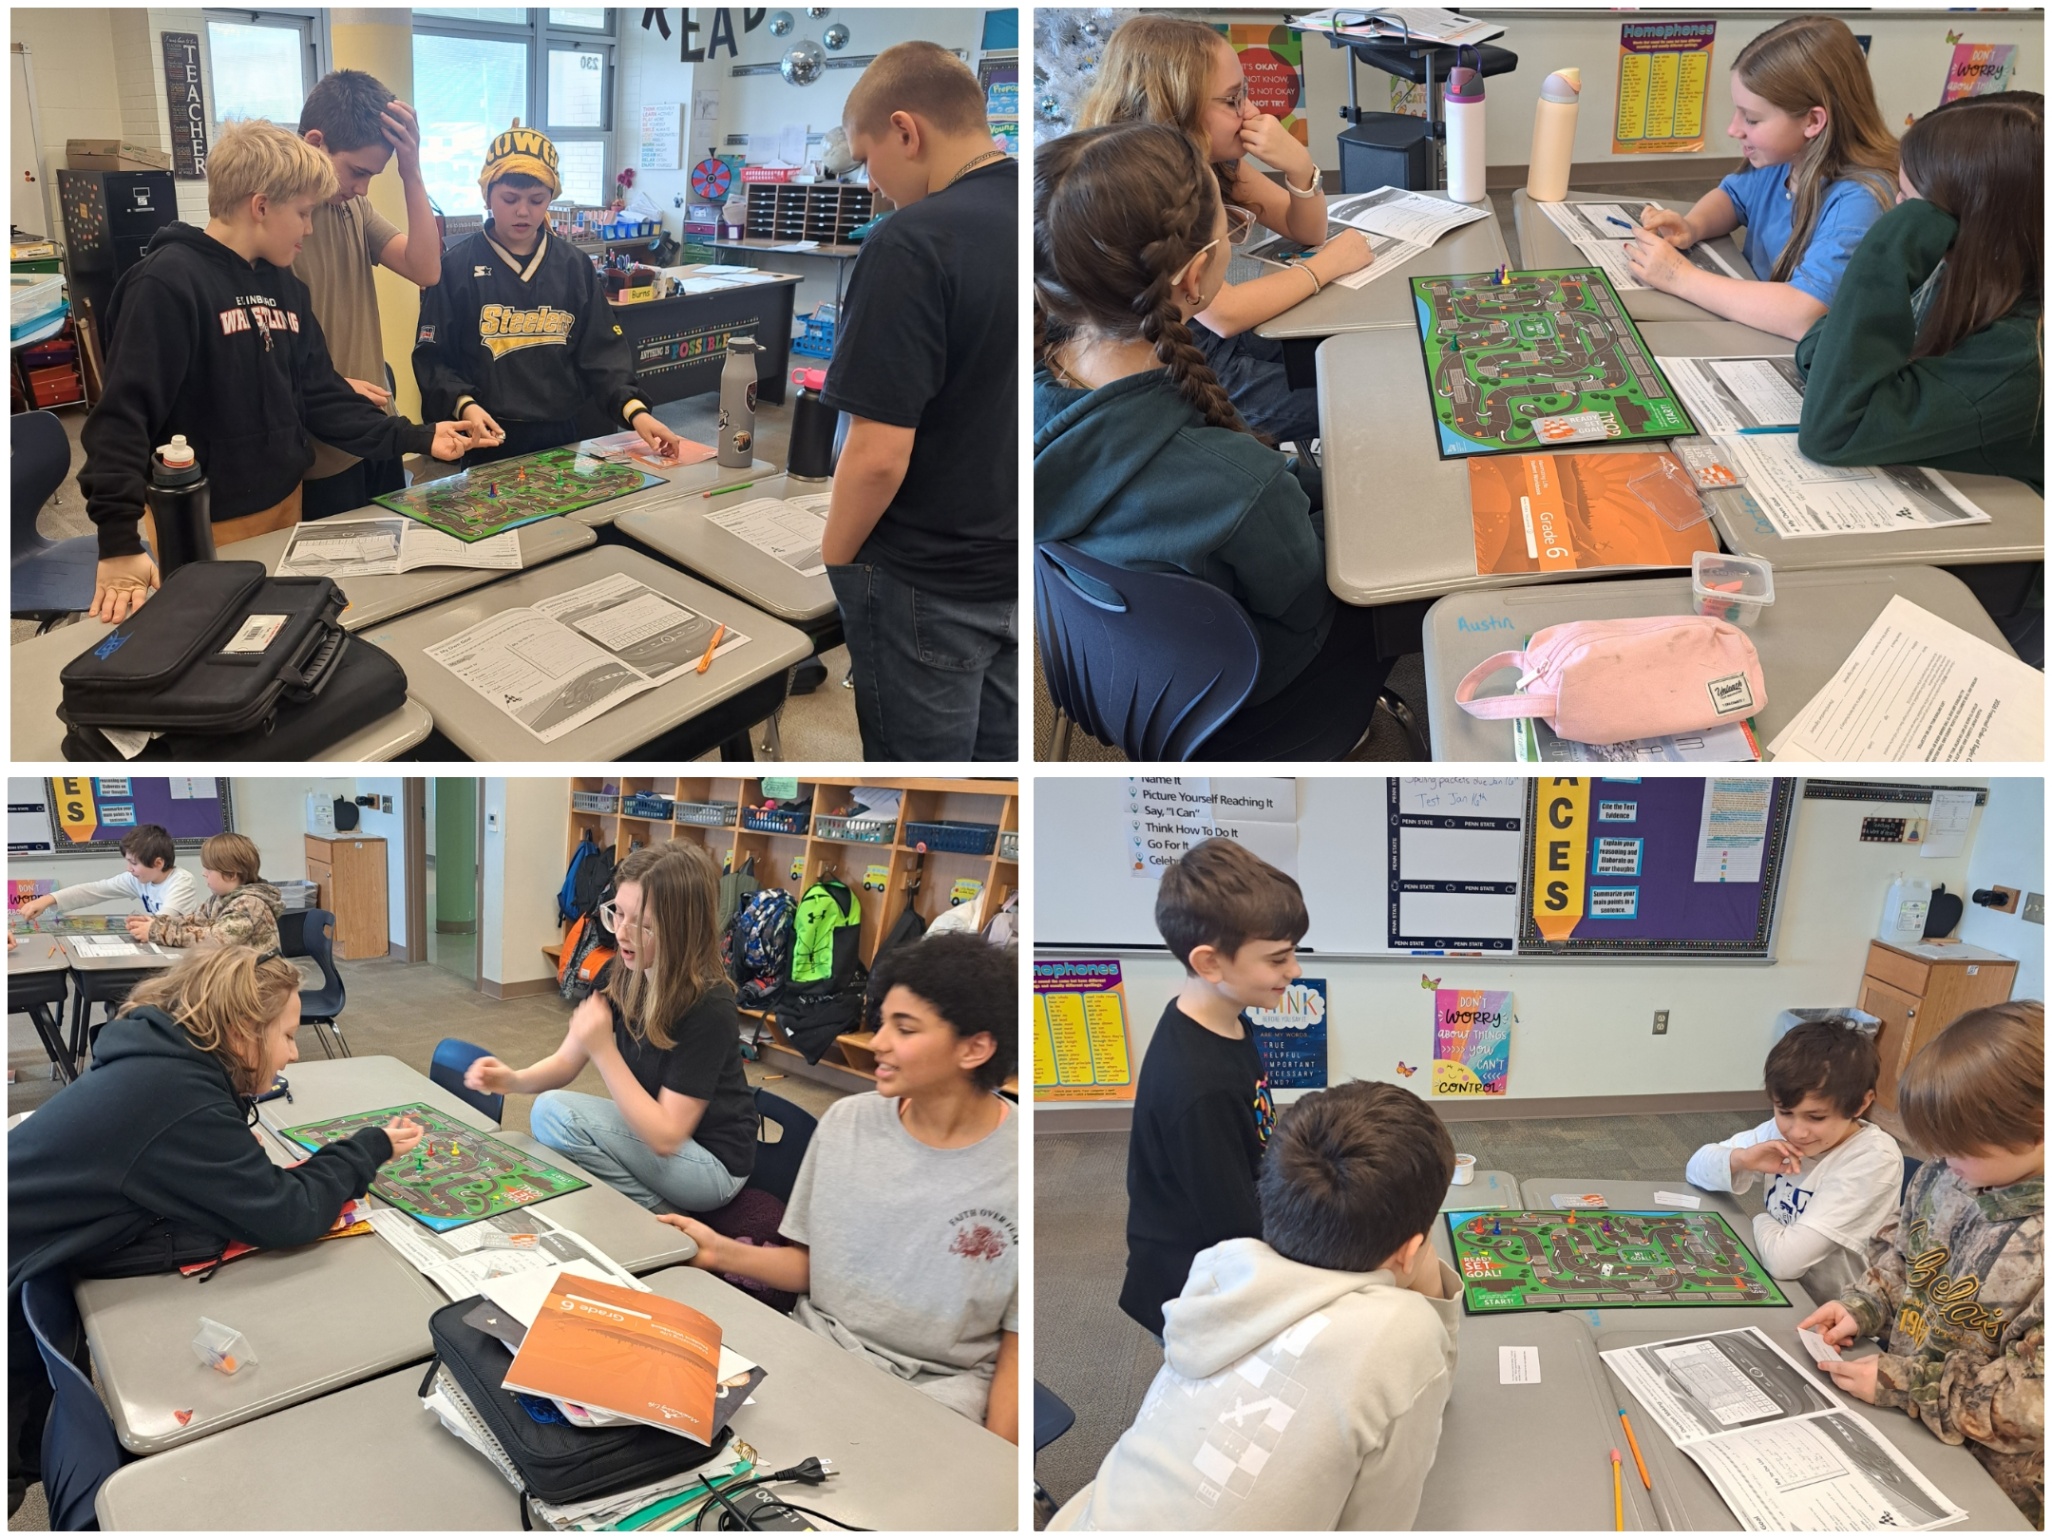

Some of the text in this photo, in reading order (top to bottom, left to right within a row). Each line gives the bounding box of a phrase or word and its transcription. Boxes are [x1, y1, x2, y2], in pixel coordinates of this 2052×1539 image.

[1624, 24, 1714, 39] Homophones
[183, 44, 206, 175] TEACHER
[632, 290, 650, 298] Burns
[480, 304, 576, 339] Steelers
[671, 333, 731, 359] POSSIBLE
[1540, 511, 1569, 559] Grade 6
[1457, 616, 1515, 632] Austin
[1439, 777, 1470, 789] packets
[1473, 777, 1487, 786] due
[1489, 777, 1503, 786] Jan
[1143, 790, 1273, 809] Picture Yourself Reaching It
[1415, 792, 1487, 808] Test Jan 16th
[1145, 806, 1164, 818] Say,
[1145, 822, 1238, 838] Think How To Do It
[1147, 840, 1189, 850] Go For It
[1256, 991, 1317, 1015] INK
[1460, 996, 1487, 1008] DON'T
[1446, 1009, 1501, 1028] WORRY
[1473, 1030, 1507, 1040] THINGS
[1477, 1058, 1504, 1070] CAN'T
[1439, 1082, 1498, 1093] CONTROL
[1466, 1268, 1502, 1278] GOAL!
[558, 1297, 624, 1322] Grade 6
[1753, 1515, 1767, 1531] Goal
